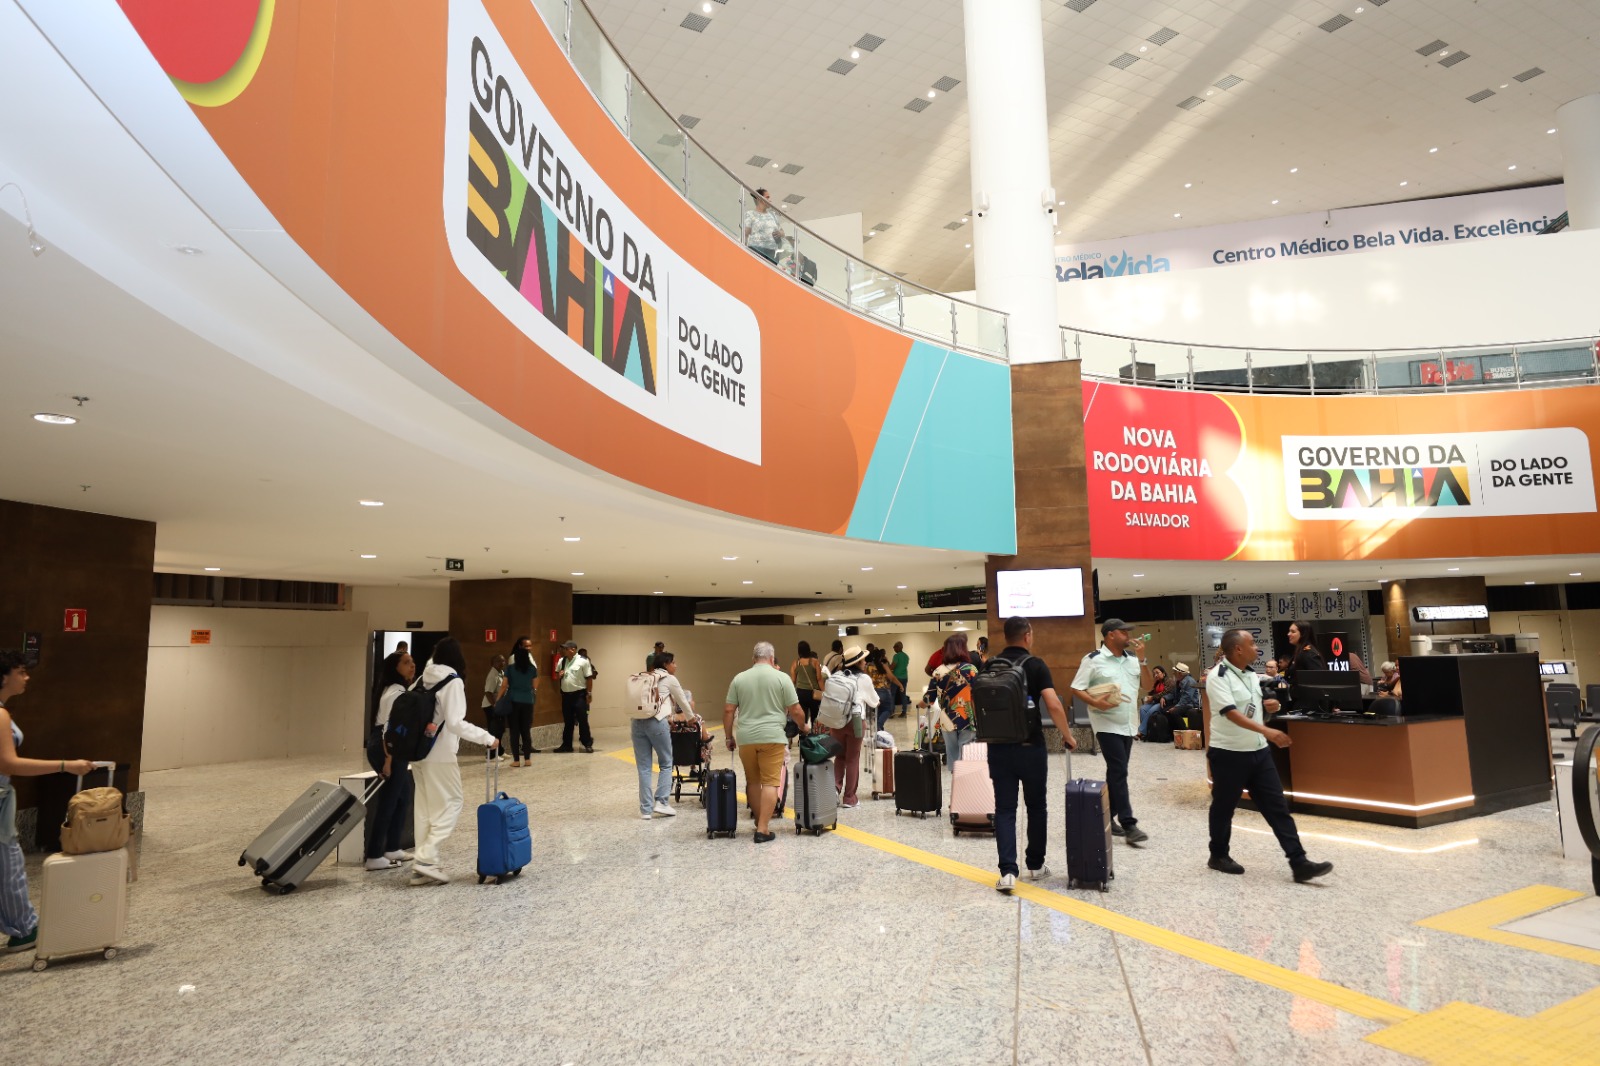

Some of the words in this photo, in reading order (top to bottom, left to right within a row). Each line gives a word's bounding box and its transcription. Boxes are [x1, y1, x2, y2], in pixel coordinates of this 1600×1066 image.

[471, 36, 614, 261] GOVERNO
[623, 232, 657, 302] DA
[466, 102, 658, 396] BAHIA
[1213, 247, 1276, 264] Centro
[1280, 237, 1349, 257] Médico
[1353, 231, 1395, 249] Bela
[1399, 227, 1449, 245] Vida.
[1454, 215, 1556, 240] Excelênci
[678, 315, 701, 351] DO
[703, 333, 743, 375] LADO
[678, 348, 699, 384] DA
[701, 369, 746, 408] GENTE
[1420, 359, 1475, 385] Bob's
[1123, 426, 1177, 449] NOVA
[1093, 451, 1213, 478] RODOVIÁRIA
[1298, 446, 1420, 467] GOVERNO
[1429, 444, 1466, 464] DA
[1491, 459, 1516, 472] DO
[1521, 456, 1568, 470] LADO
[1110, 480, 1137, 502] DA
[1140, 482, 1198, 504] BAHIA
[1300, 466, 1471, 508] BAHIA
[1492, 474, 1516, 488] DA
[1519, 472, 1573, 486] GENTE
[1125, 511, 1190, 528] SALVADOR
[1327, 657, 1349, 671] TÁXI
